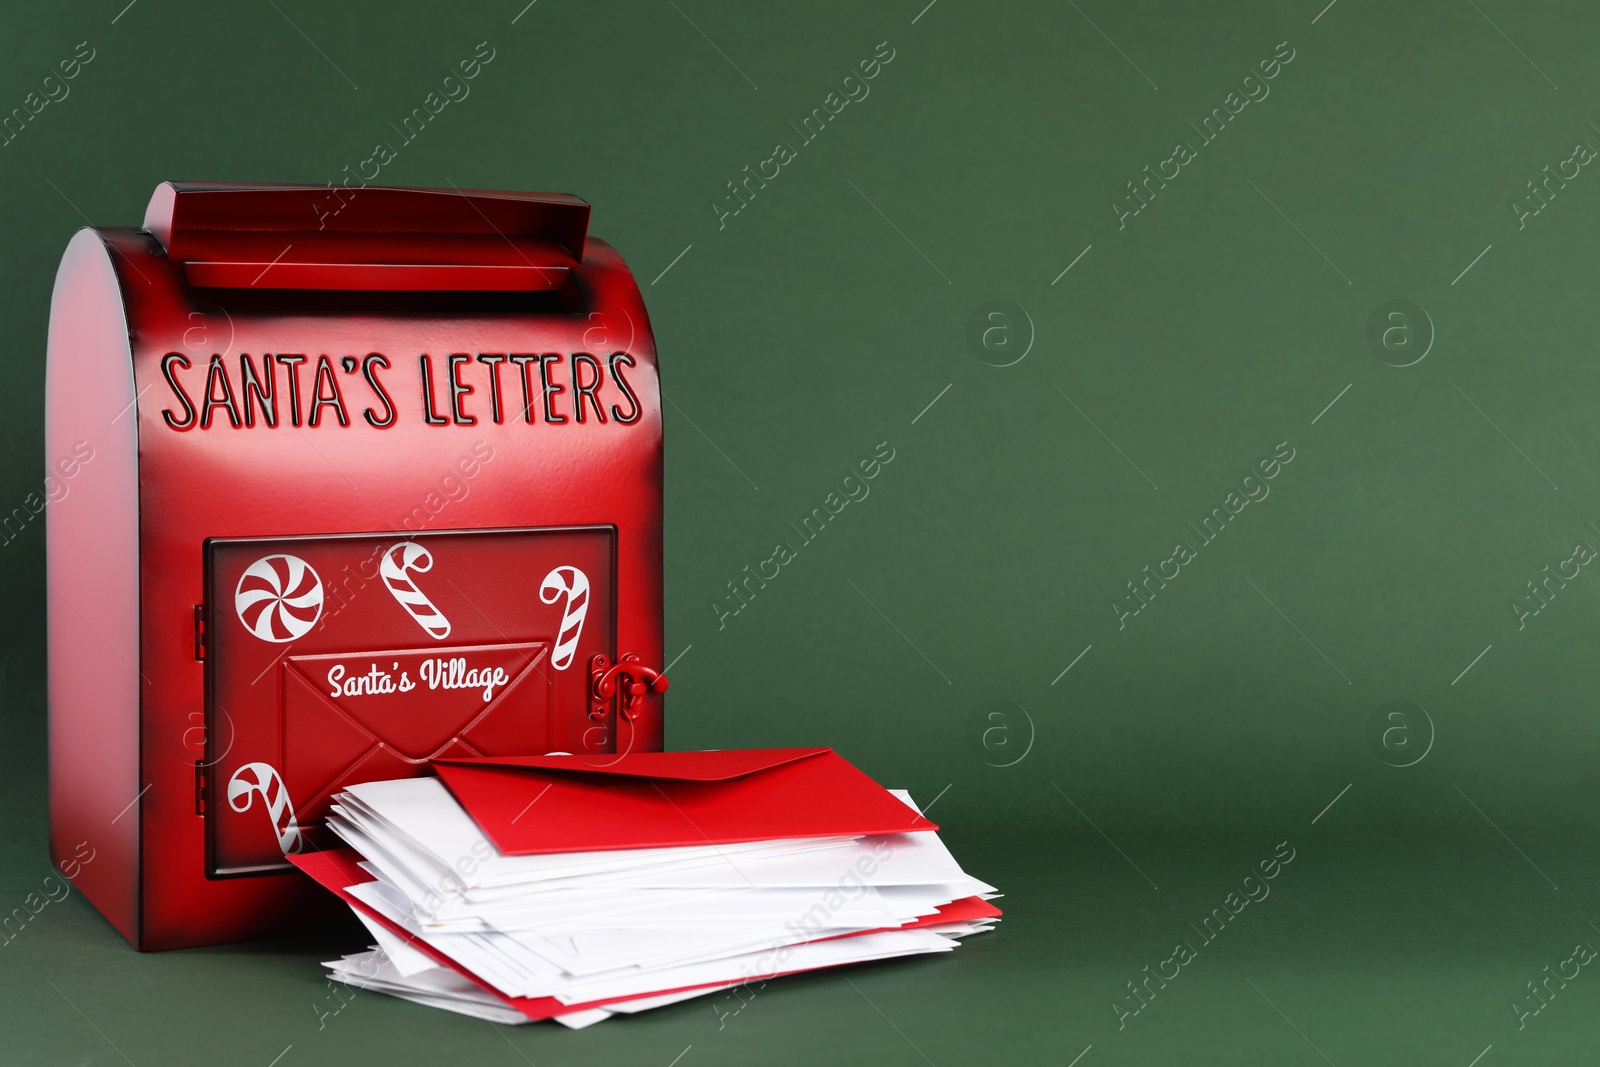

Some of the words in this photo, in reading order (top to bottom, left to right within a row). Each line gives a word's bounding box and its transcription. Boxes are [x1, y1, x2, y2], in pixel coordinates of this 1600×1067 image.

[160, 351, 397, 431] SANTA'S
[418, 351, 642, 428] LETTERS
[327, 661, 416, 698] Santa's
[420, 657, 509, 702] Village
